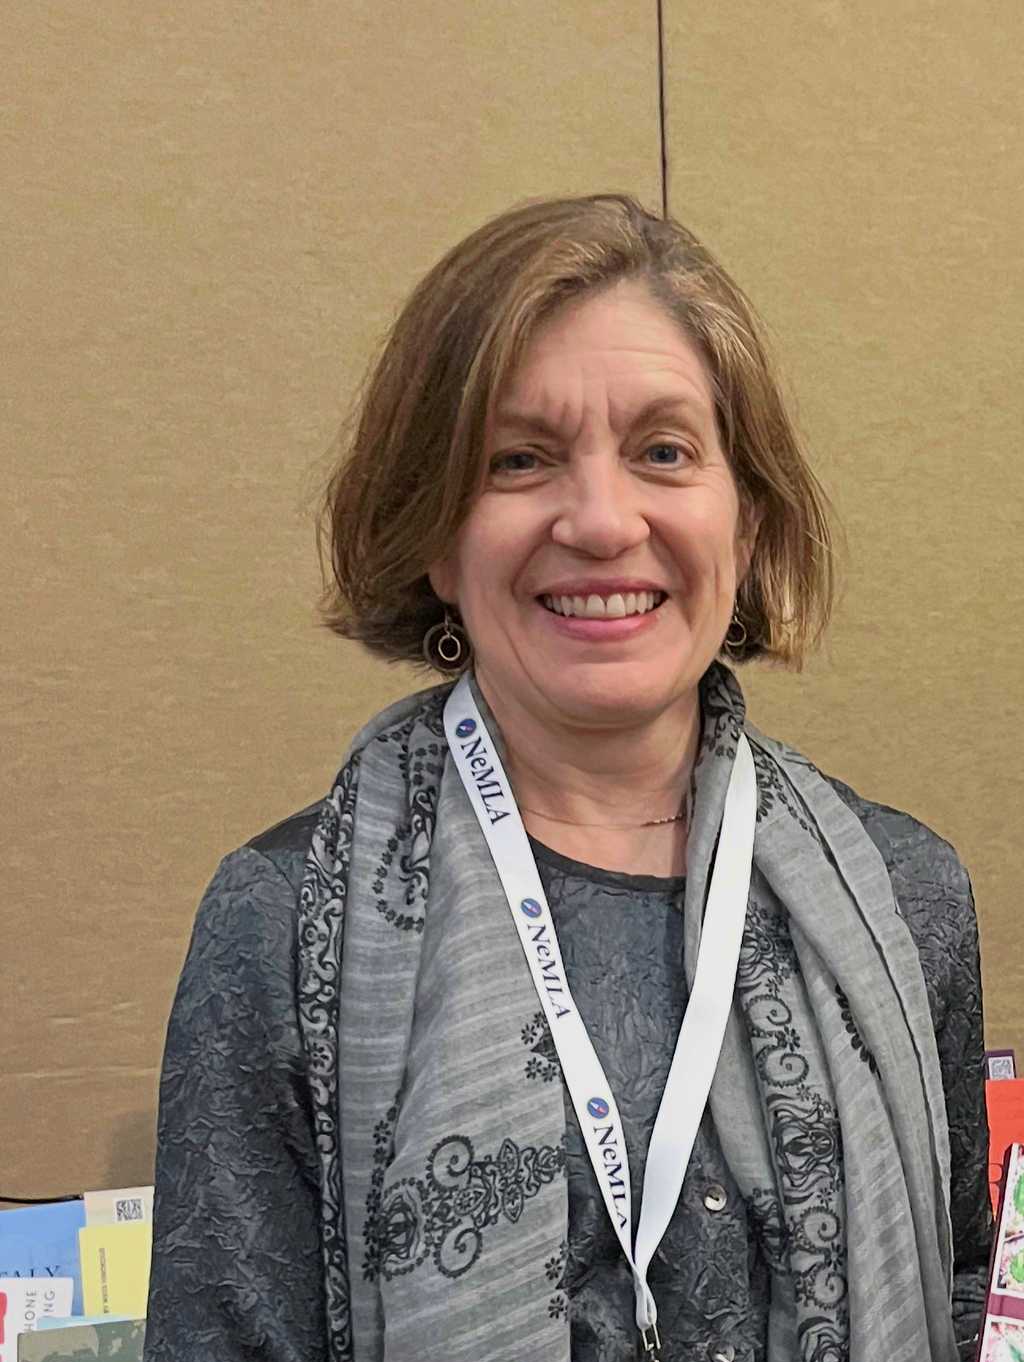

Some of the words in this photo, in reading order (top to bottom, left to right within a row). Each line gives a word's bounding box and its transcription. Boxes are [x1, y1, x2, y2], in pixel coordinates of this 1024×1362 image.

[460, 735, 512, 826] NeMLA
[528, 923, 570, 1020] NeMLA
[593, 1124, 628, 1229] NeMLA
